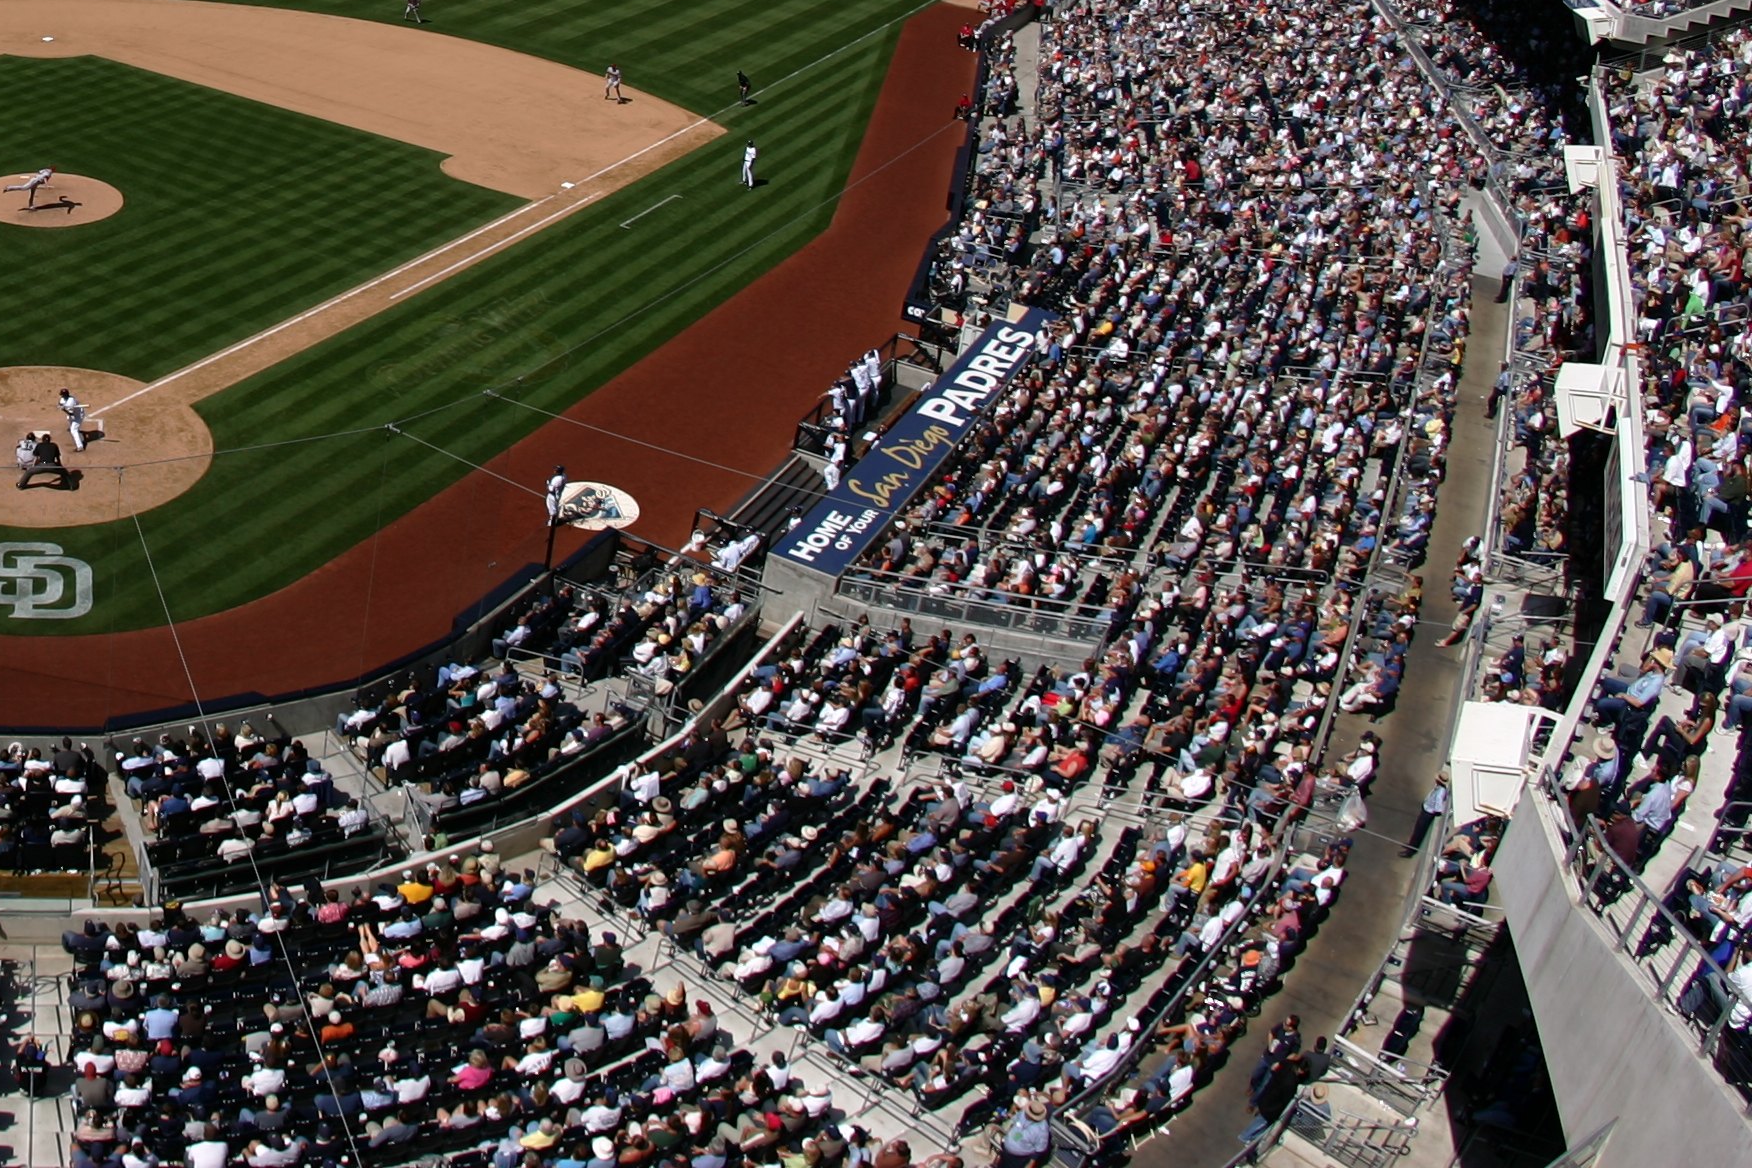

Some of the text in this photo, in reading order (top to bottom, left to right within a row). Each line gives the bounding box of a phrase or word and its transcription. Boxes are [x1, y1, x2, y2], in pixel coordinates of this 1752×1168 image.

[847, 326, 1035, 508] San Diego PADRES
[788, 509, 854, 562] HOME
[834, 509, 879, 552] OF YOUR
